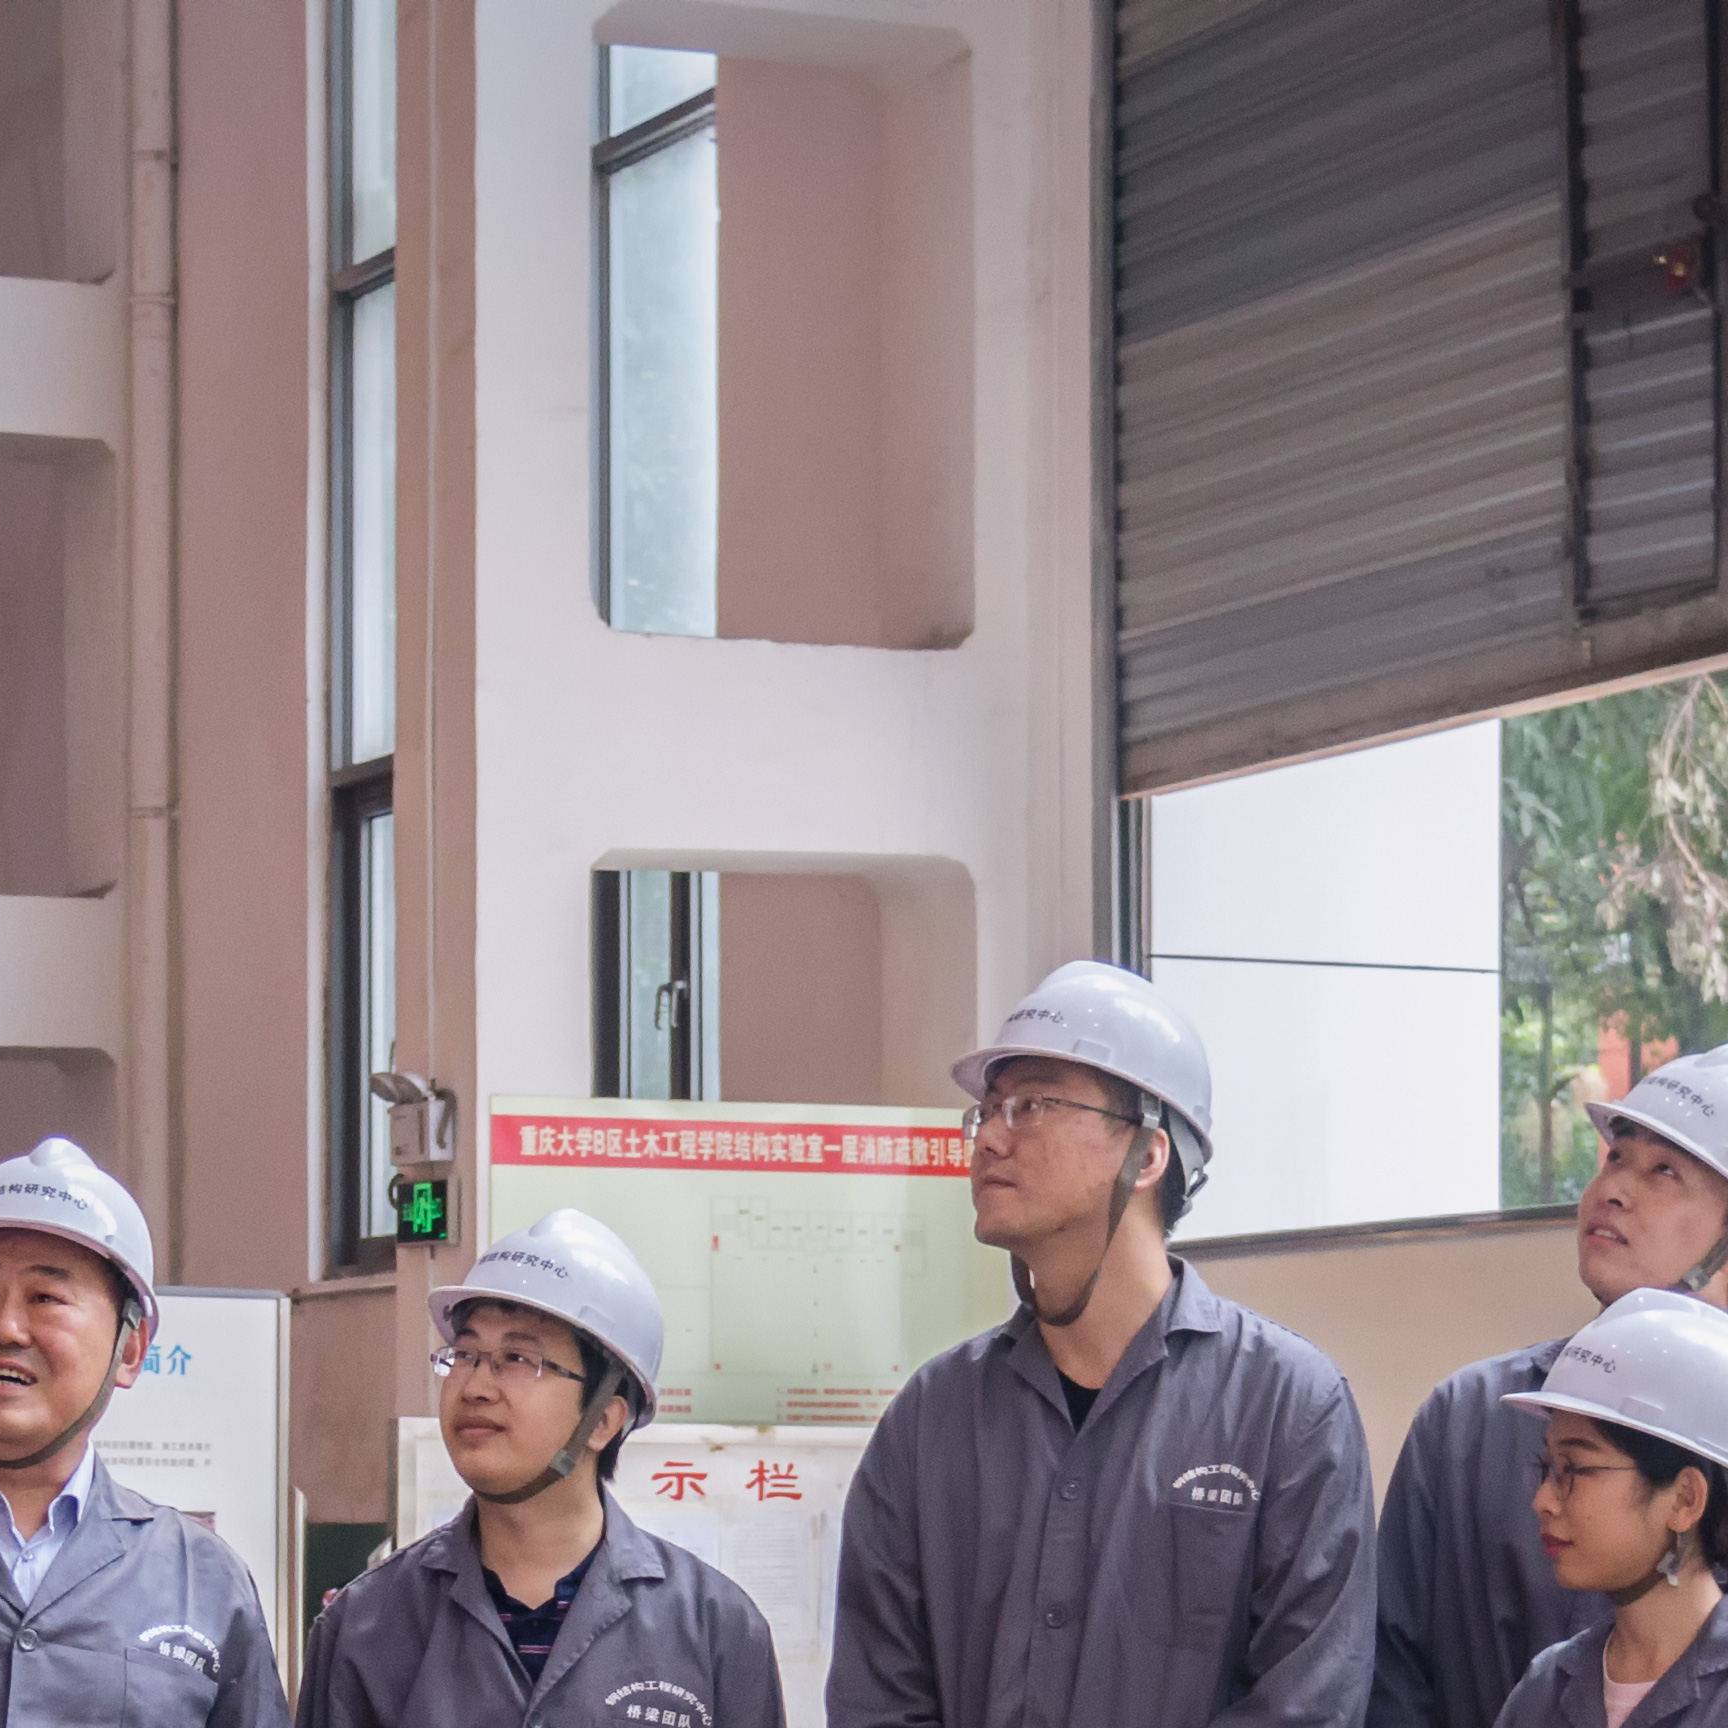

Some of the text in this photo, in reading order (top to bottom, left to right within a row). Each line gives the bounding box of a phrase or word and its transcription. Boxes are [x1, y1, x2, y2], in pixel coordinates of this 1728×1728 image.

[605, 1680, 713, 1727] 钢结构工程研究中心
